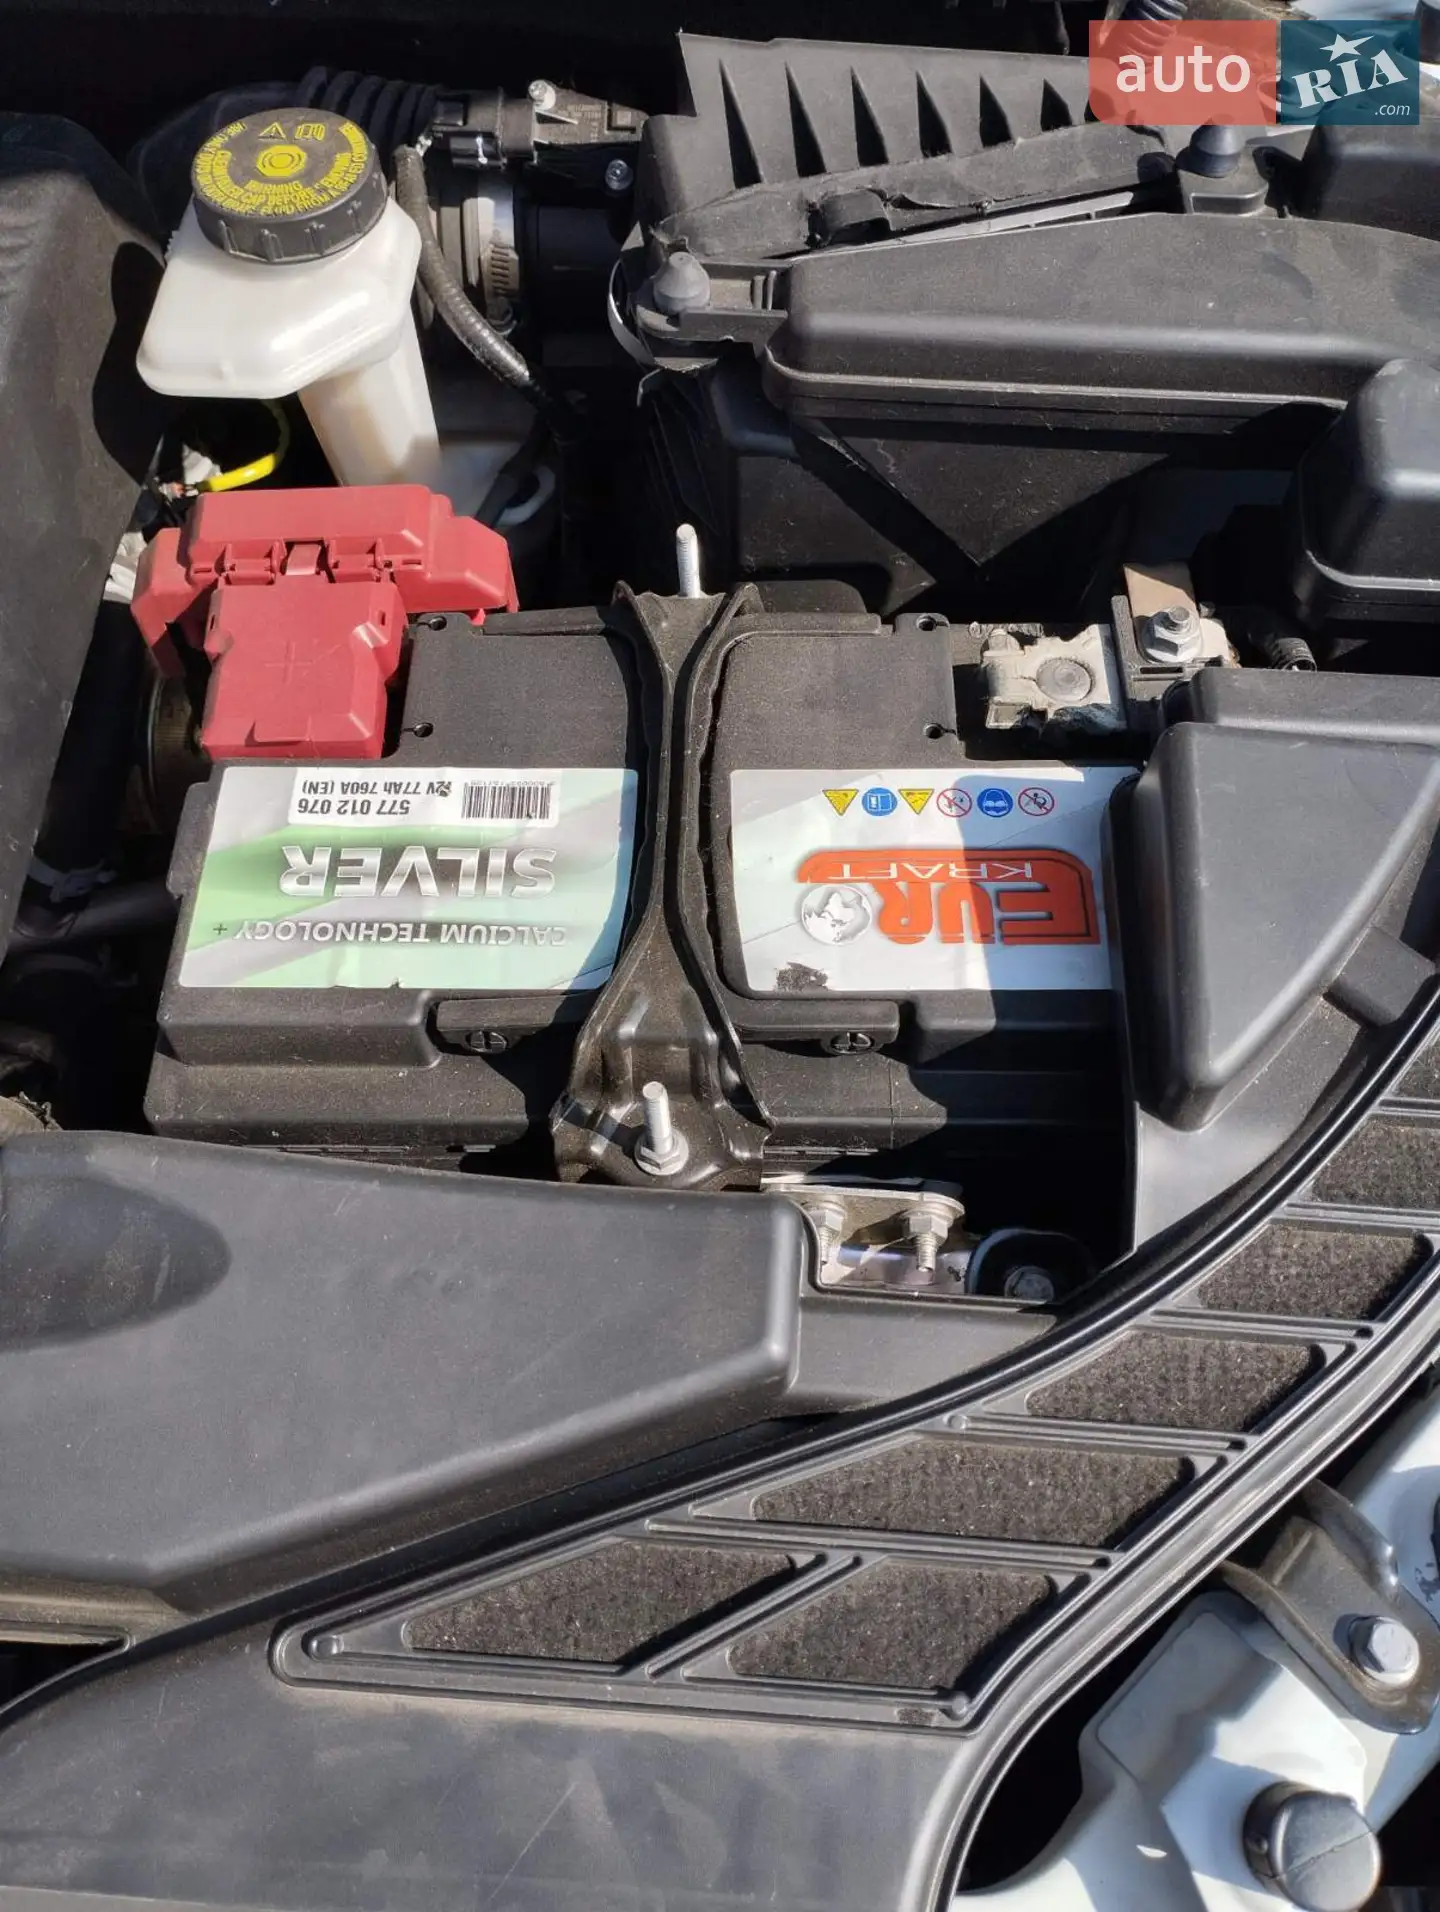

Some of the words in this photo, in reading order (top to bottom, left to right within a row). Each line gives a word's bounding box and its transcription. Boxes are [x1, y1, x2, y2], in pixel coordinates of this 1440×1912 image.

[302, 781, 334, 795] (EN)
[340, 781, 378, 795] 760A
[383, 781, 421, 795] 77Ah
[297, 799, 331, 815] 076
[336, 799, 371, 815] 012
[376, 799, 411, 815] 577
[279, 845, 557, 898] SILVER
[828, 862, 1032, 880] KRAFT
[232, 920, 431, 944] TECHNOLOGY
[440, 923, 568, 947] CALCIUM
